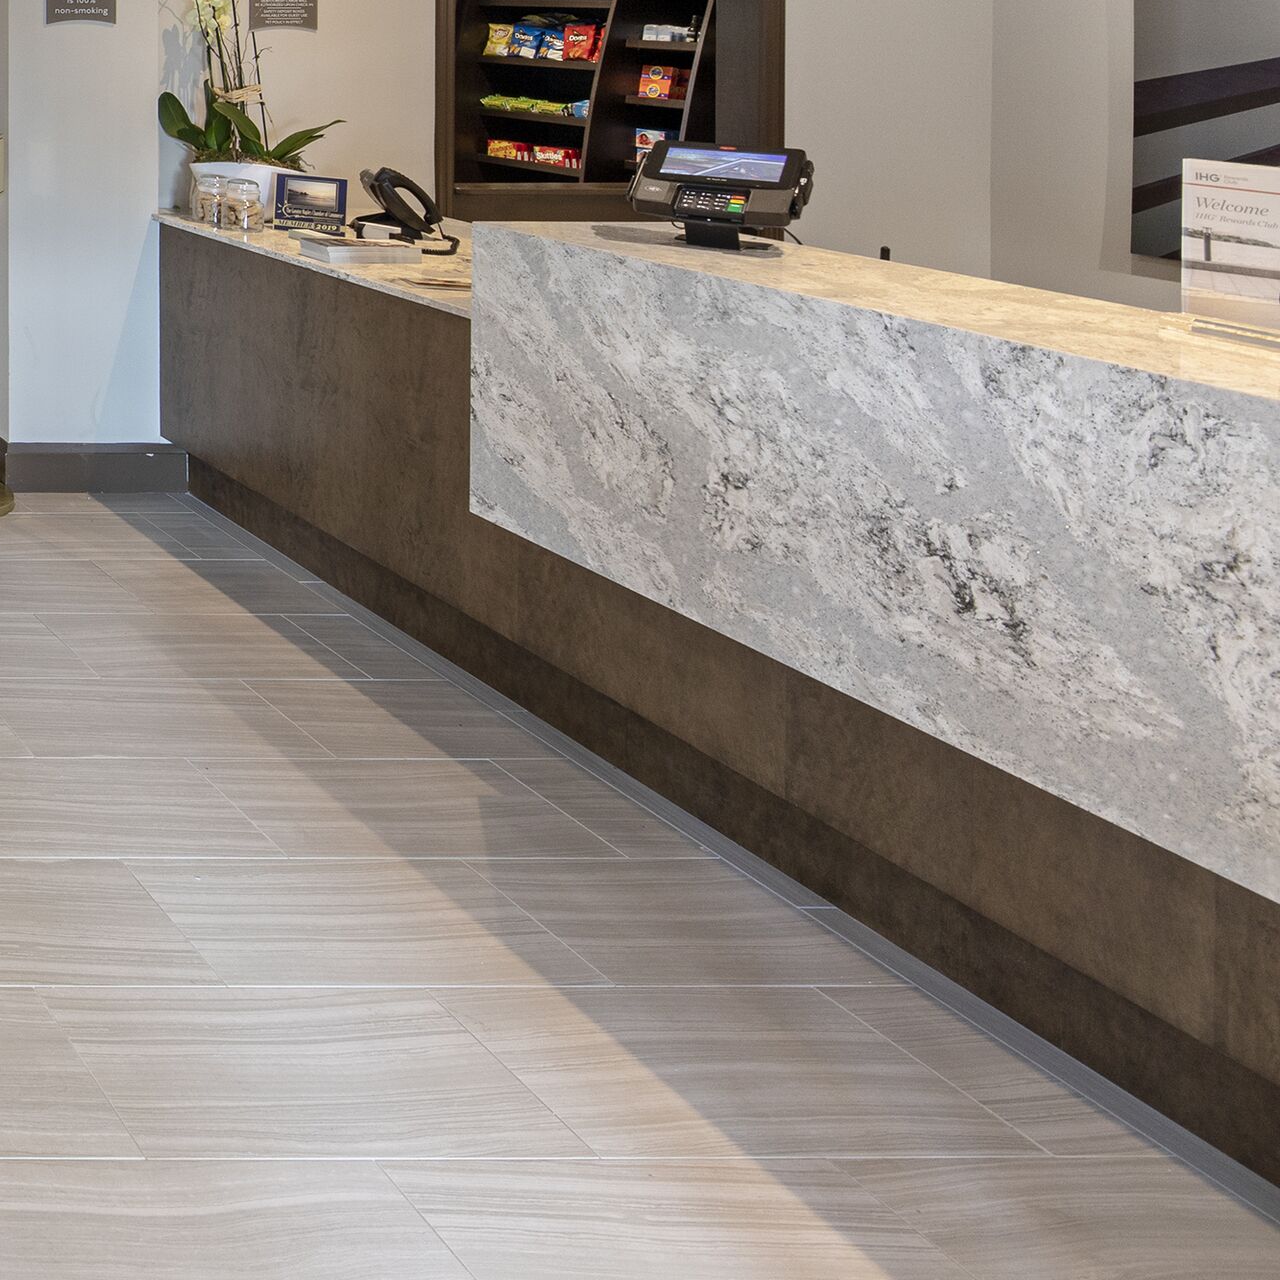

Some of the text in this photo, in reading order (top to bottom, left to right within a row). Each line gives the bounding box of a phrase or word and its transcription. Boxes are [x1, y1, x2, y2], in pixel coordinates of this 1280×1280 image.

[54, 7, 109, 16] non-smoking
[536, 151, 563, 161] Skittles
[1195, 171, 1220, 183] IHG
[1196, 196, 1270, 217] Welcome
[278, 219, 315, 229] MEMBER
[1219, 215, 1256, 226] Rewards
[1256, 220, 1280, 230] Club
